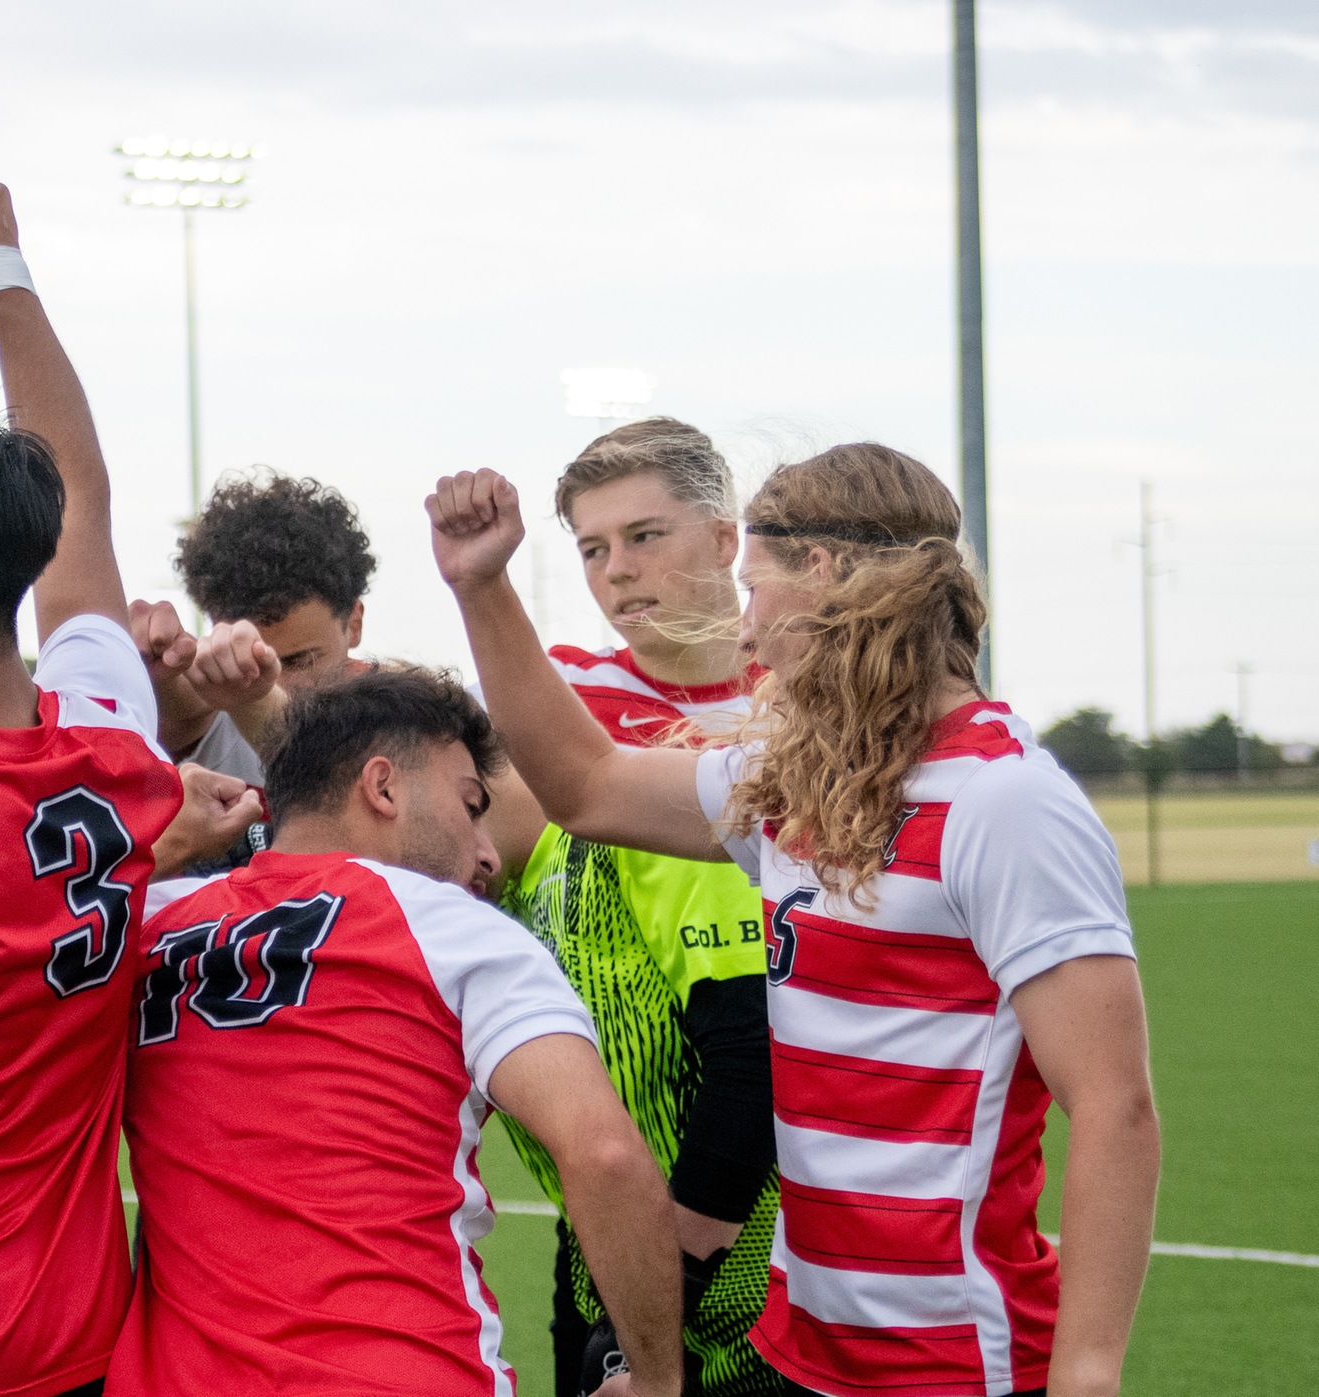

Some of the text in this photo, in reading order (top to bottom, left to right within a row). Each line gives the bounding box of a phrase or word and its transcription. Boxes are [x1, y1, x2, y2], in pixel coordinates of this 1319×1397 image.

[24, 784, 134, 999] 3
[679, 923, 730, 949] Col.
[767, 886, 820, 987] 5
[138, 891, 345, 1048] 10
